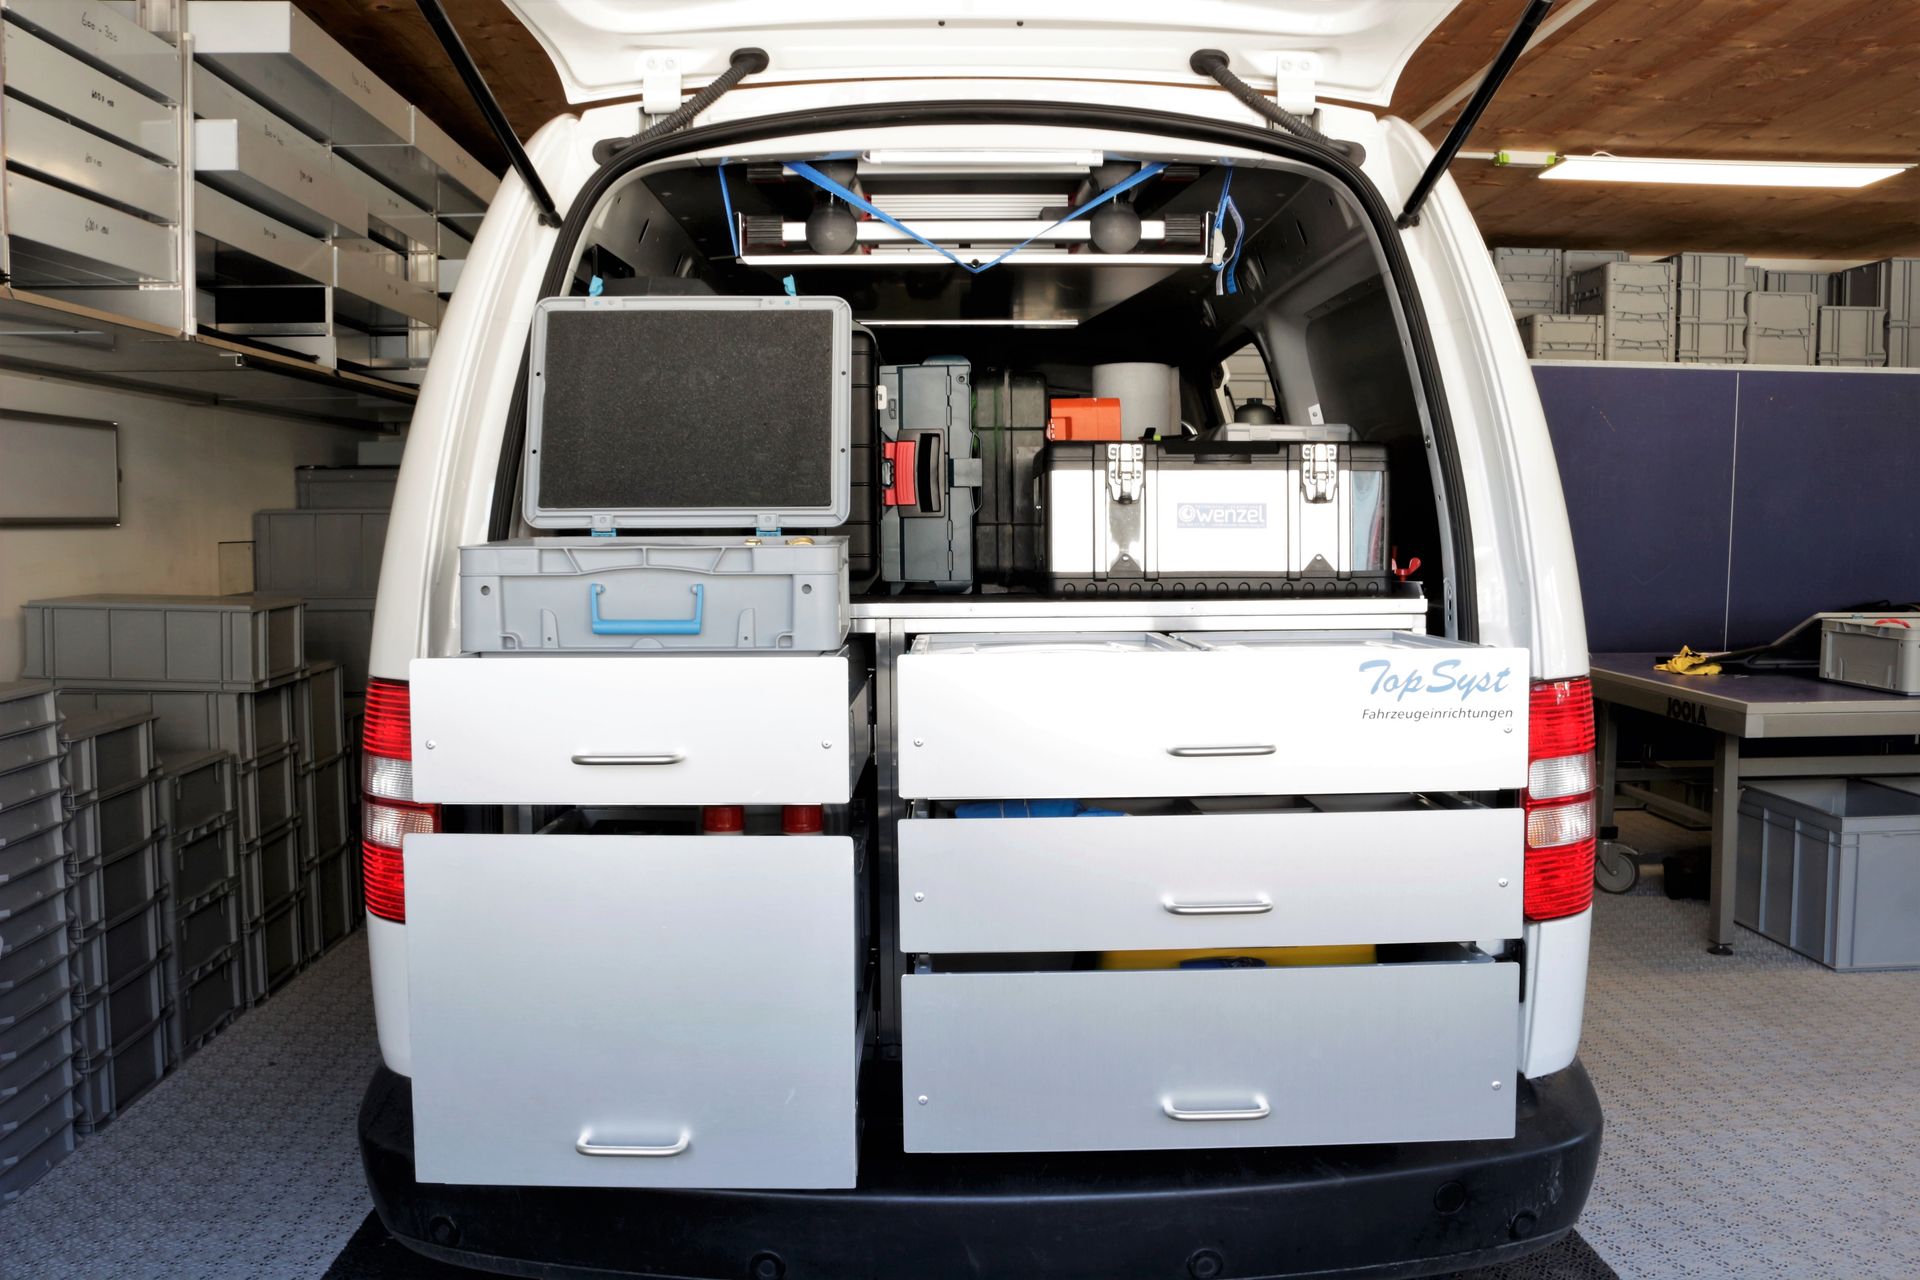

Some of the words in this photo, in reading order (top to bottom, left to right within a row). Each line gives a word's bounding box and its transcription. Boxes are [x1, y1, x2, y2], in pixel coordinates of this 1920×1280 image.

[1196, 504, 1265, 523] wenzel
[1362, 708, 1514, 722] Fahrzeugeinrichtungen
[1666, 697, 1708, 727] JOOLA
